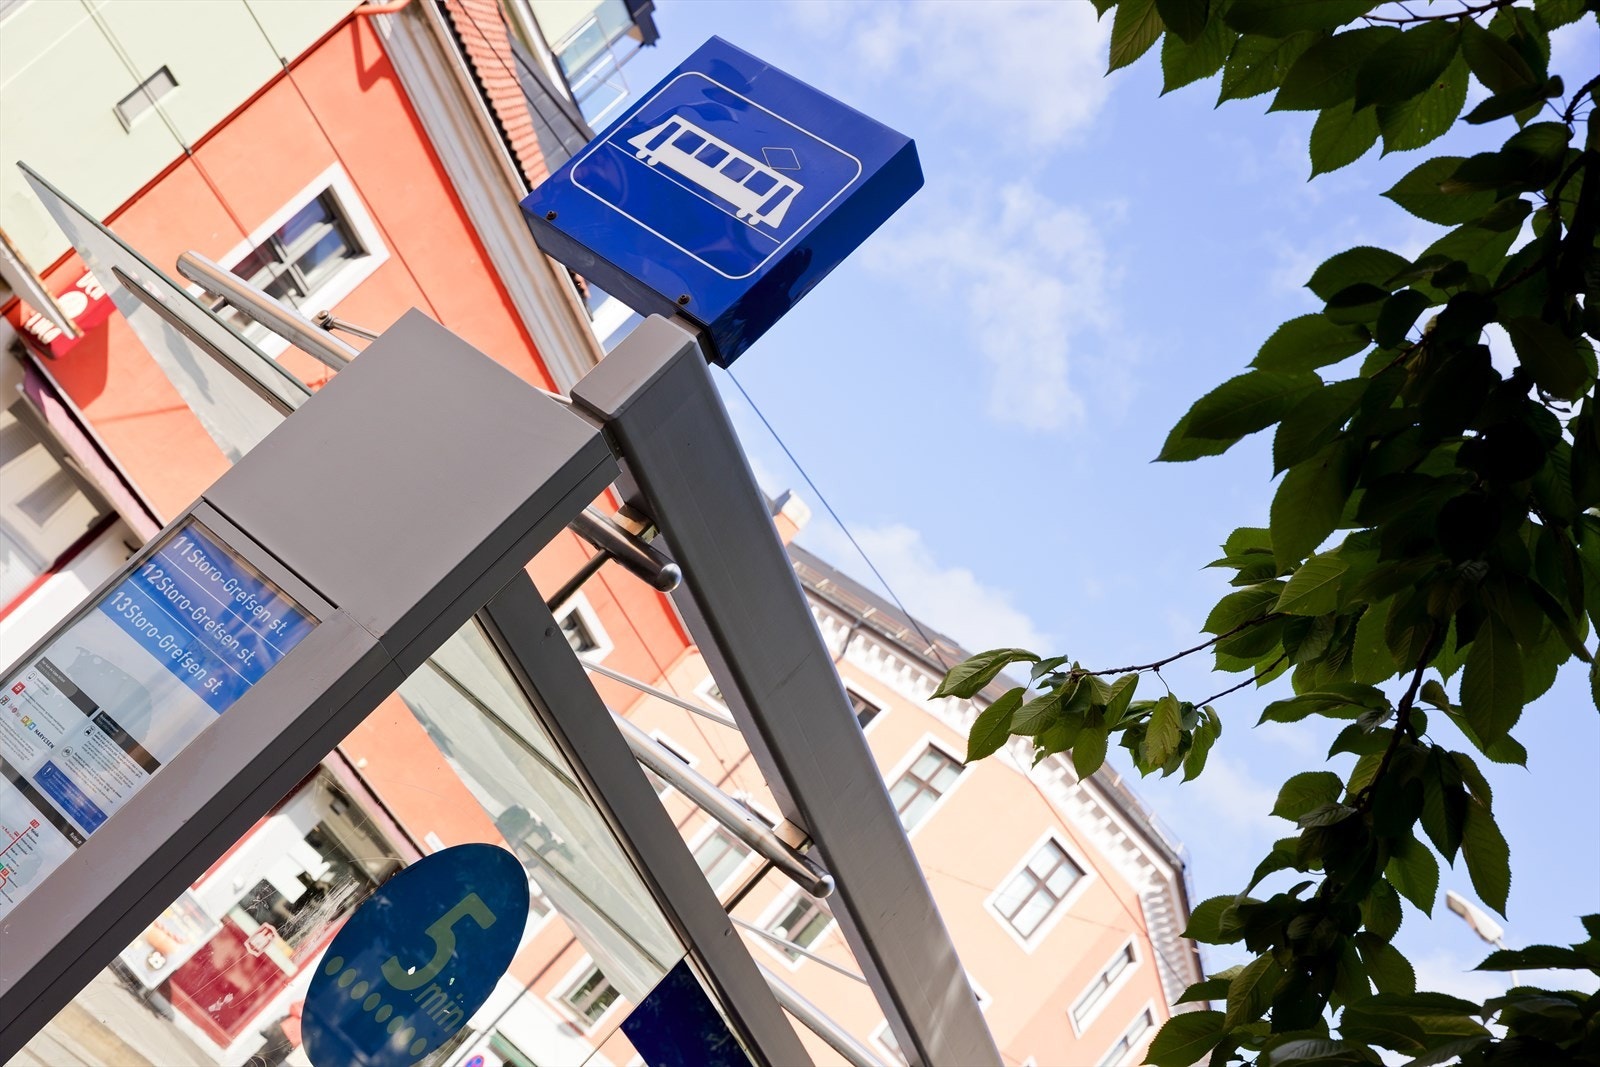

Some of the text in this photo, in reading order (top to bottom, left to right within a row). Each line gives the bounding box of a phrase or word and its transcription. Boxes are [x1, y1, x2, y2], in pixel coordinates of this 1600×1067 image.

[268, 619, 289, 637] st.
[236, 648, 256, 667] st.
[203, 677, 224, 696] st.
[34, 728, 55, 750] NARVESEN
[381, 892, 497, 1033] 5 min
